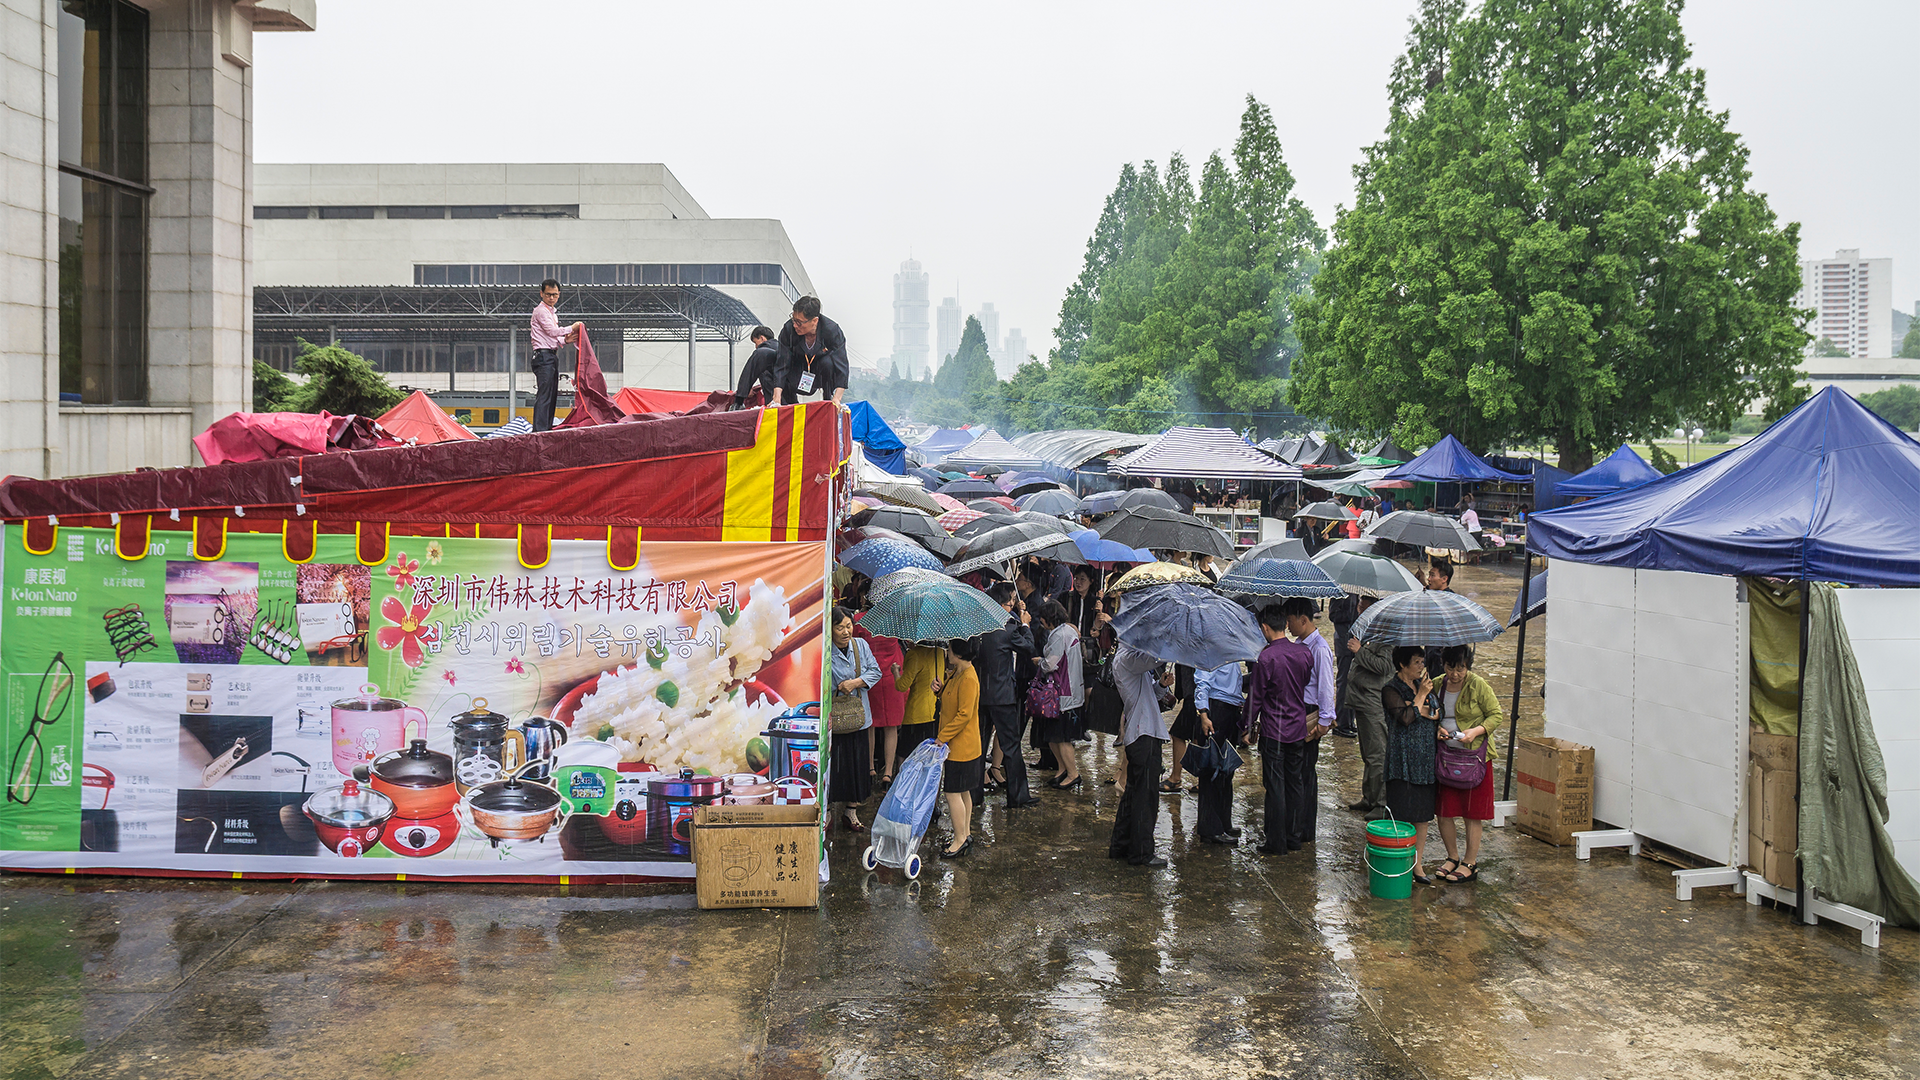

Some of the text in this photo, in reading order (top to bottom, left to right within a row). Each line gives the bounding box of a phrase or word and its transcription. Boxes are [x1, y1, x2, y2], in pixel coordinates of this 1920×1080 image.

[24, 568, 66, 585] 康医视
[46, 588, 77, 602] Nano
[412, 574, 738, 615] 深圳市伟林技术科技有限公司
[419, 620, 726, 660] 심전시위림기술유한공사
[228, 681, 252, 692] 艺术包装
[315, 761, 335, 771] 工艺升
[224, 818, 249, 829] 材料升级
